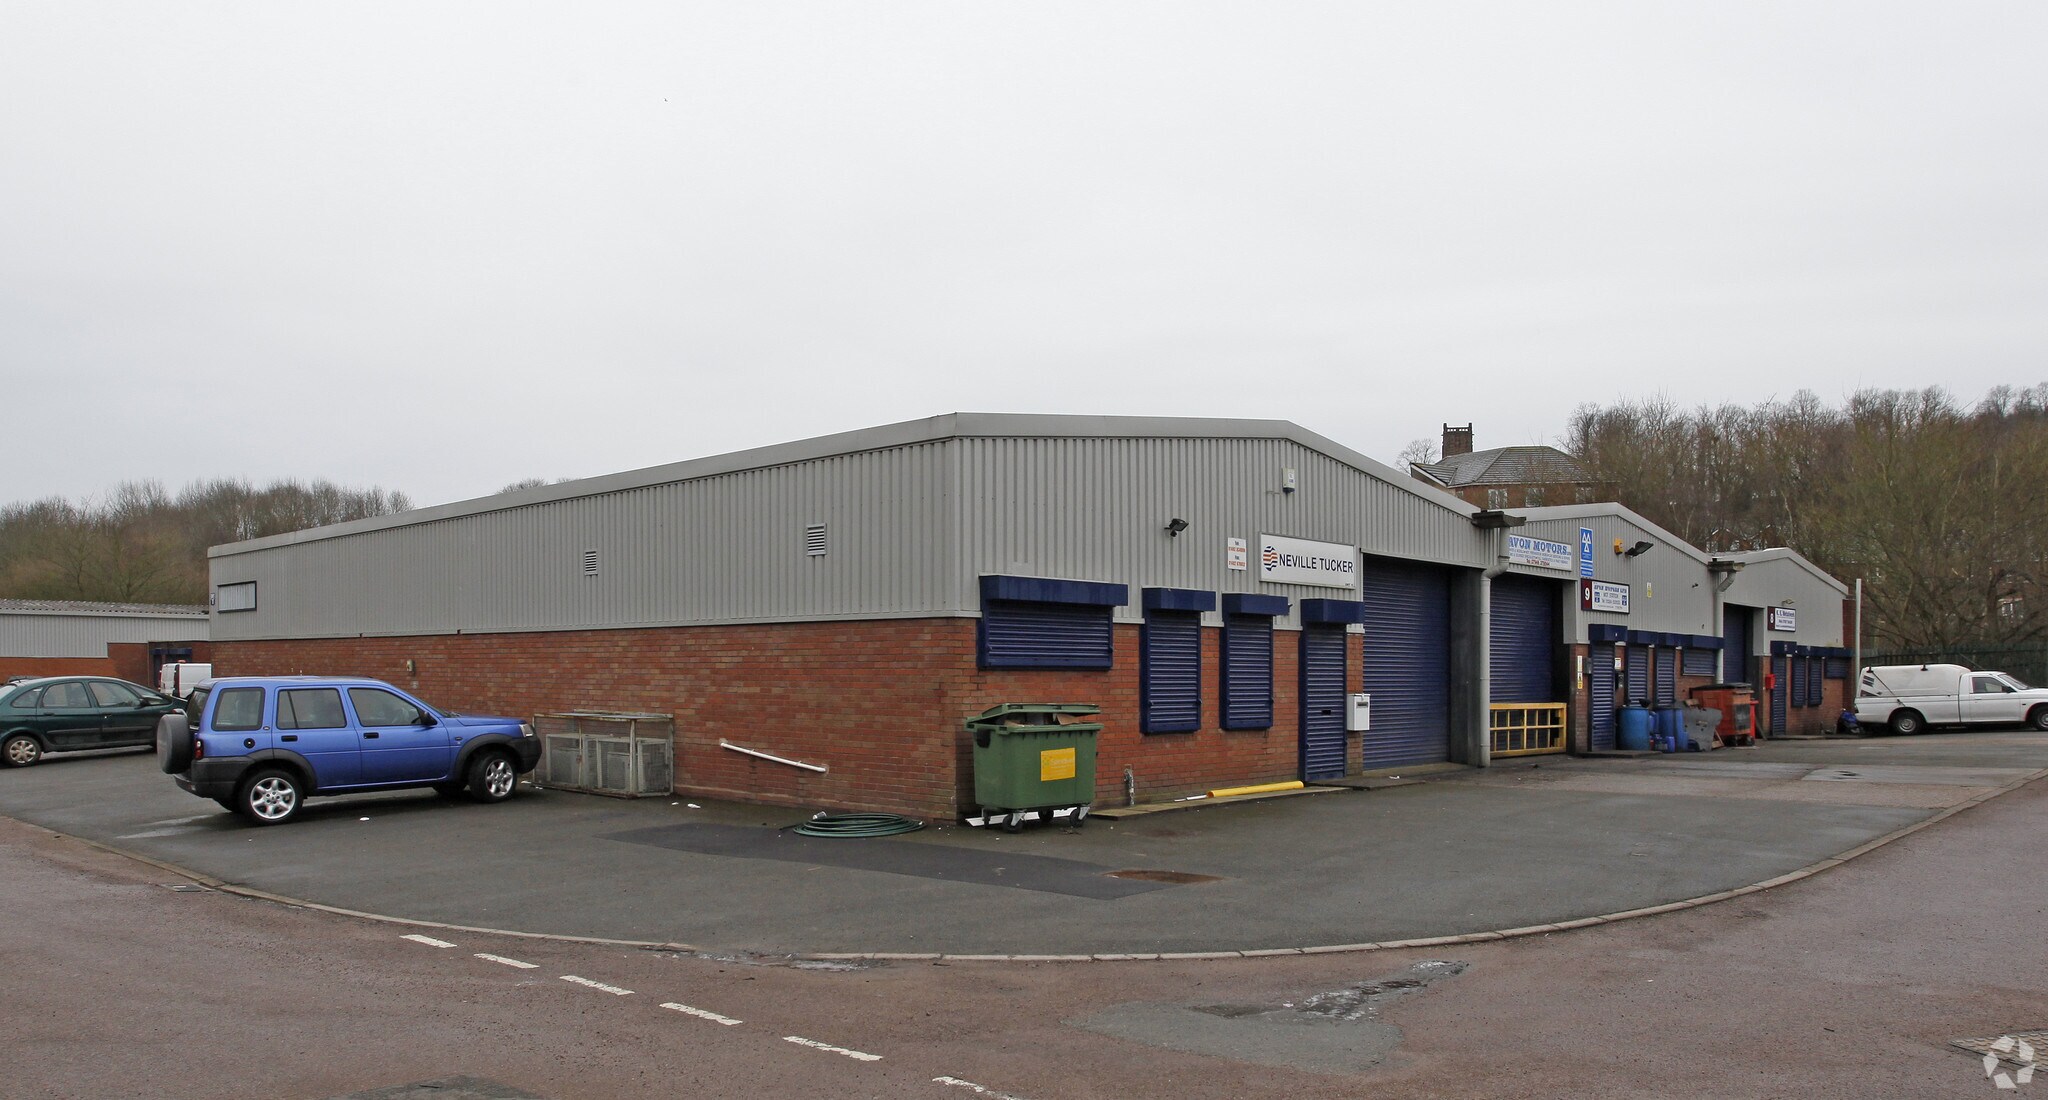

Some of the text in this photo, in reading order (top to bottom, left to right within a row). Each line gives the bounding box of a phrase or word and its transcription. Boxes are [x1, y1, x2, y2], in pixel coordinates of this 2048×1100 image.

[1509, 536, 1531, 550] AVON
[1533, 540, 1567, 556] MOTORS
[1279, 553, 1354, 573] NEVILLE TUCKER
[1584, 587, 1590, 601] 9
[1770, 613, 1774, 624] 8
